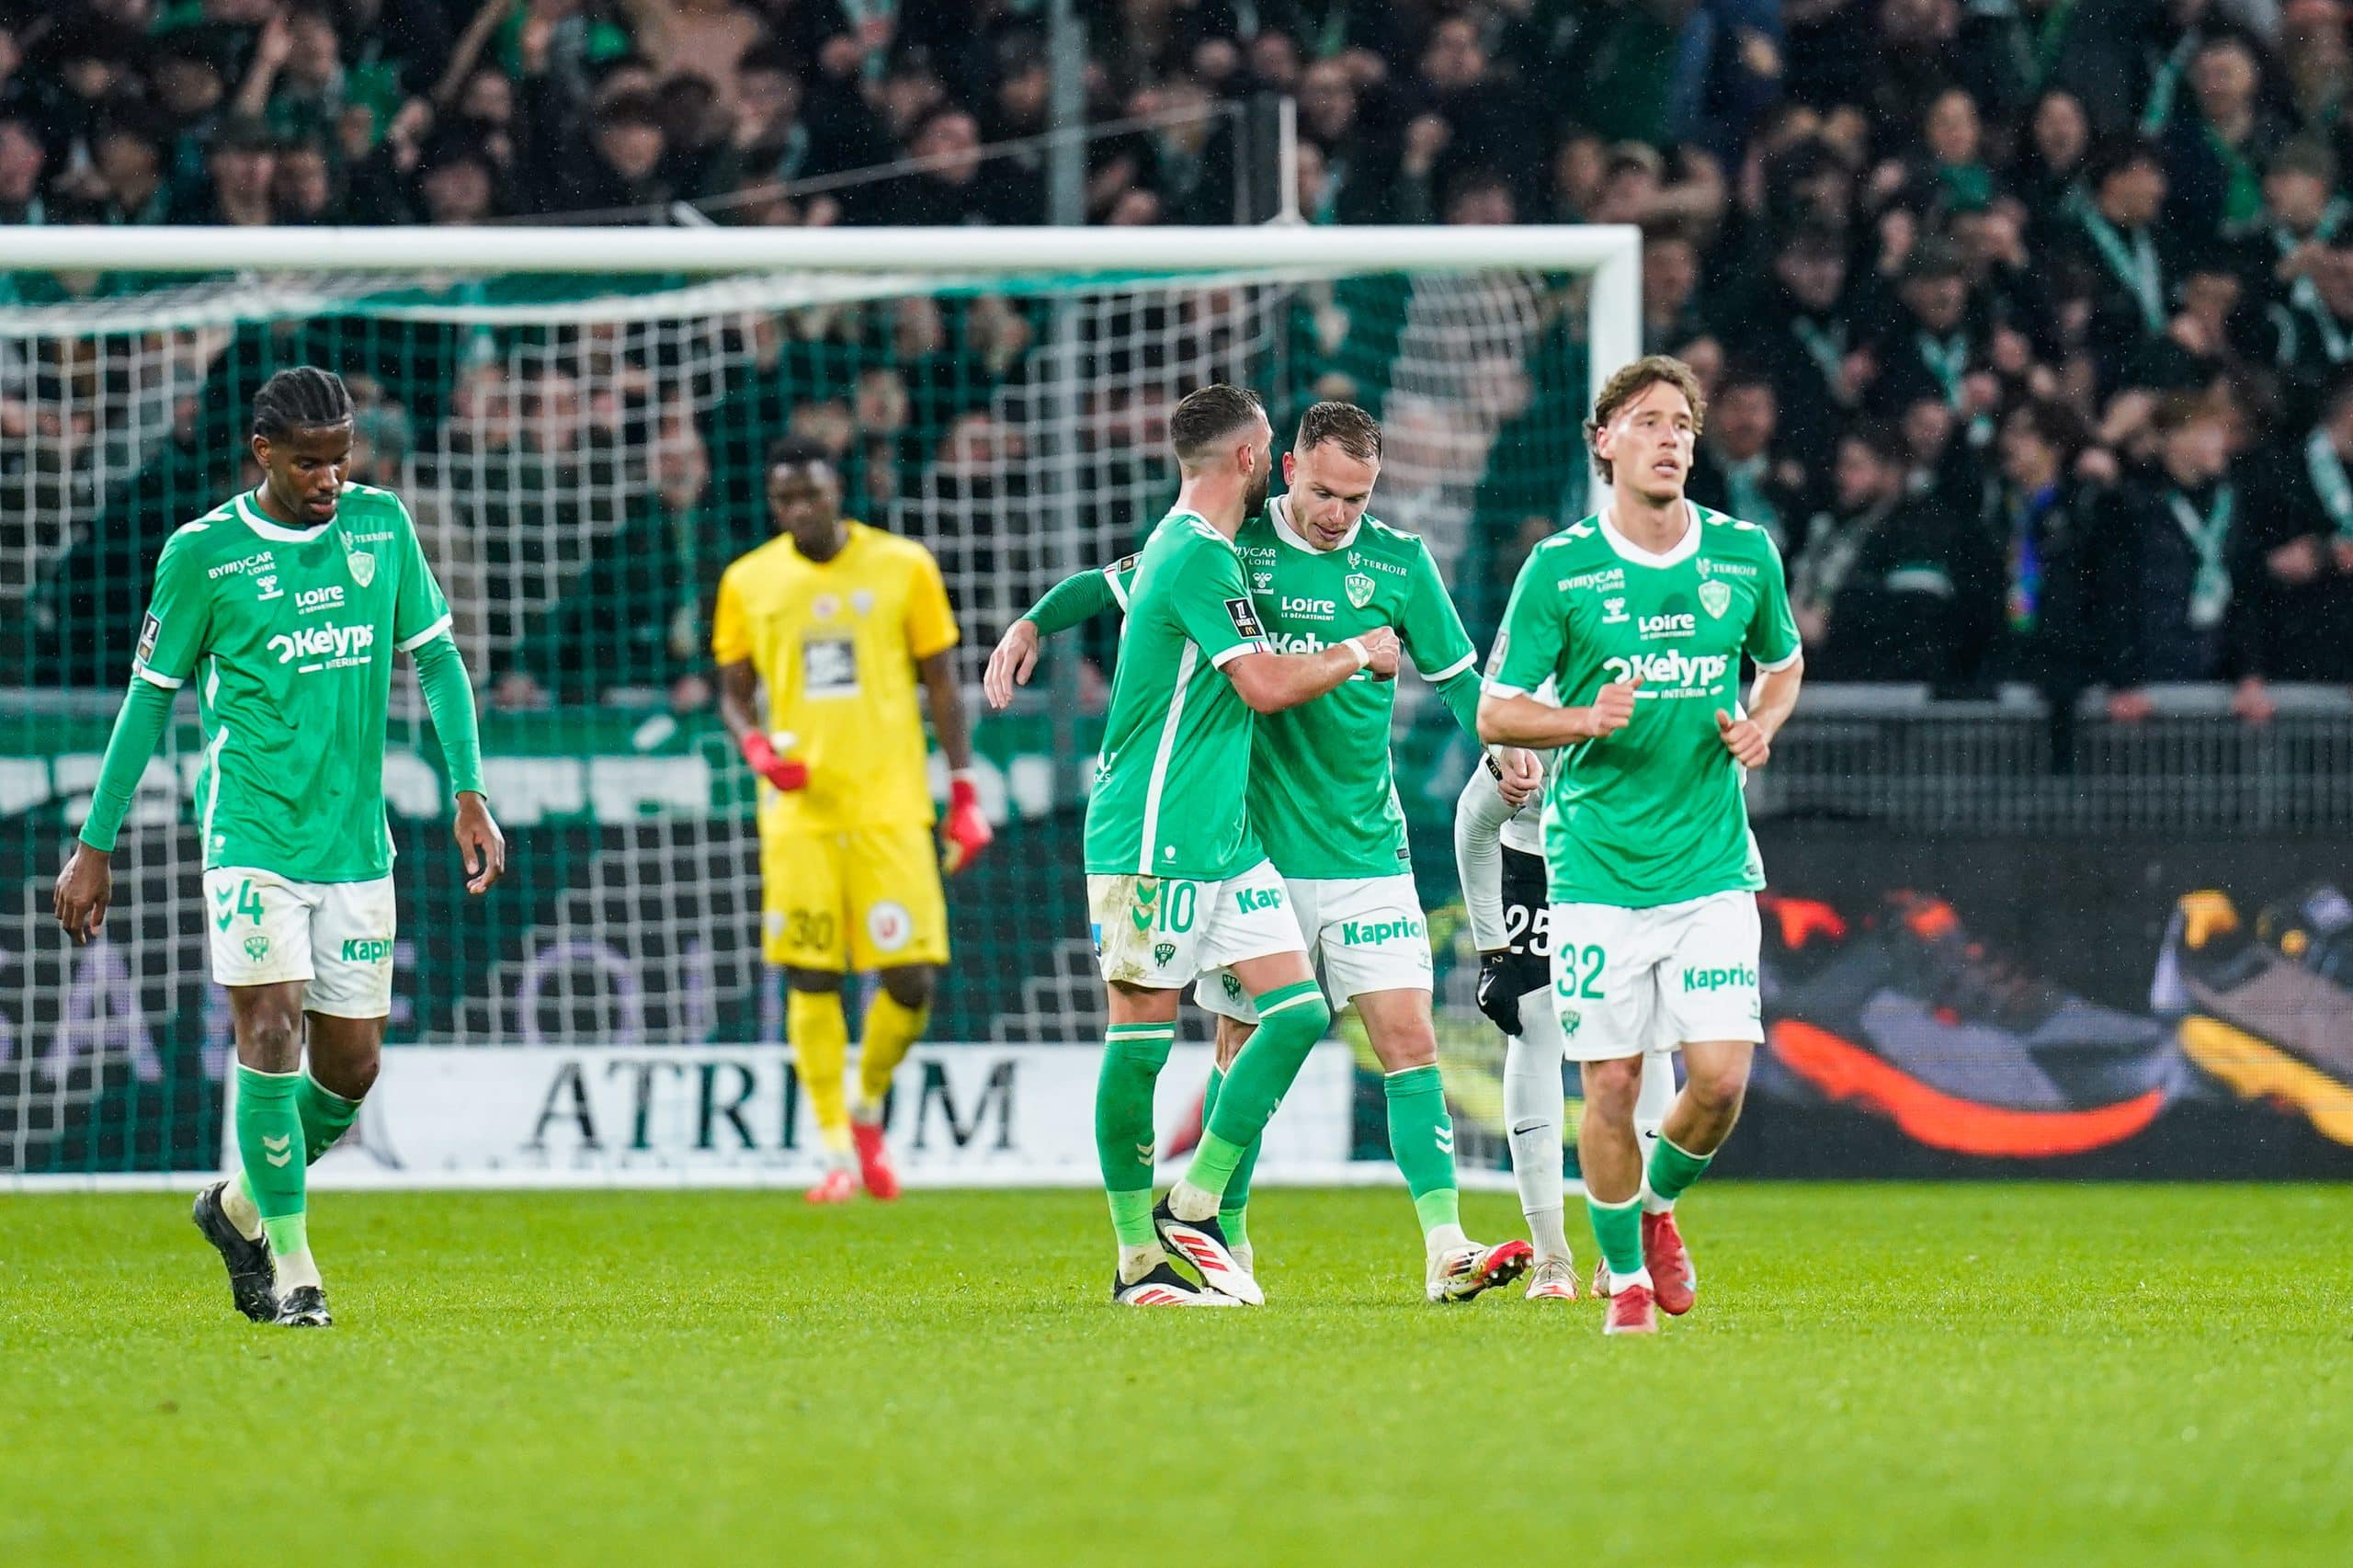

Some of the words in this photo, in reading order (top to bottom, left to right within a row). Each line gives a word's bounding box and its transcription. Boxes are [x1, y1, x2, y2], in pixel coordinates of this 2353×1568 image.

[247, 562, 277, 575] LOIRE
[1248, 558, 1277, 566] LOIRE
[1362, 558, 1407, 576] TERROIR
[294, 585, 344, 608] Loire
[1281, 596, 1336, 614] Loire
[1638, 613, 1695, 633] Loire
[1267, 631, 1340, 655] Kel
[237, 880, 265, 926] 4
[1159, 881, 1197, 933] 10
[788, 908, 833, 950] 30
[1506, 904, 1552, 956] 25
[1557, 943, 1605, 999] 32
[524, 1061, 1020, 1151] ATRIM
